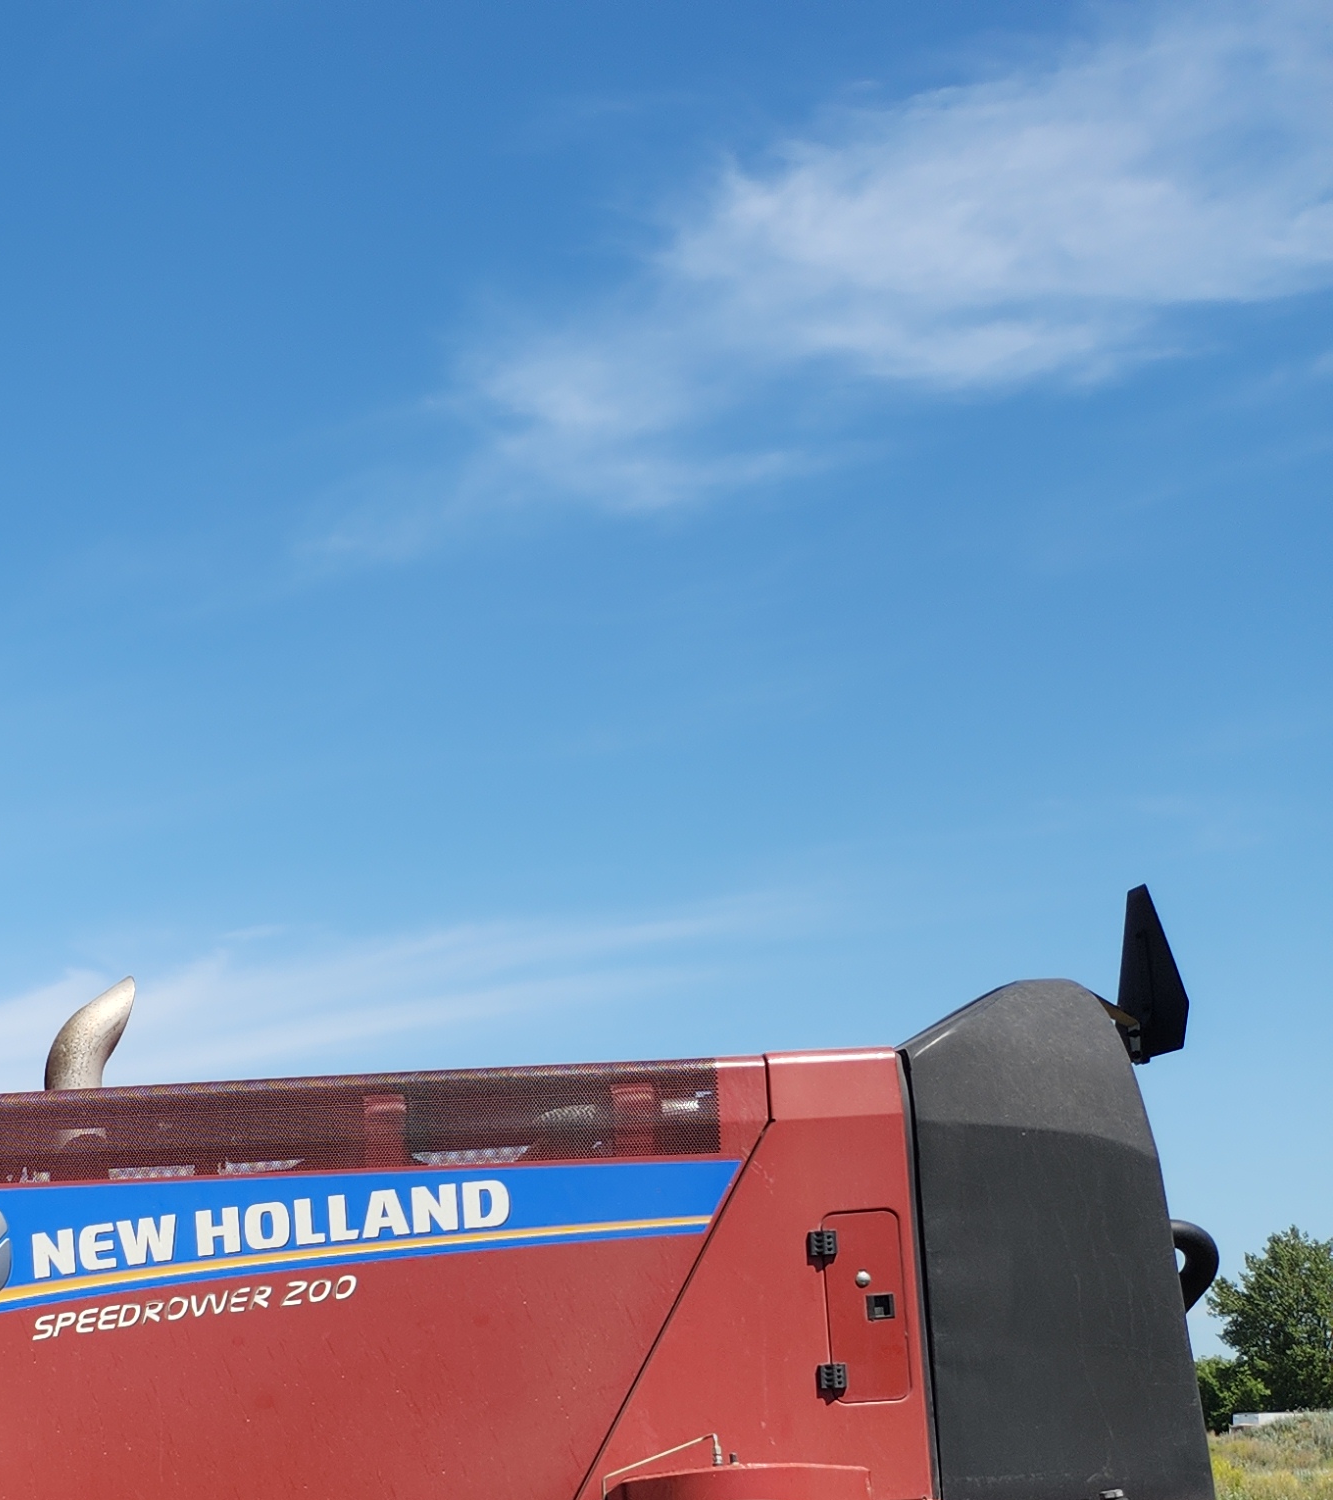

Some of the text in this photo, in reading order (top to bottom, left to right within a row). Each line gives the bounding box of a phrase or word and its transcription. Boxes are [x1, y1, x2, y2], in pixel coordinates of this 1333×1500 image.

[31, 1179, 512, 1280] NEW HOLLAND
[31, 1274, 359, 1342] SPEEDROWER 200
